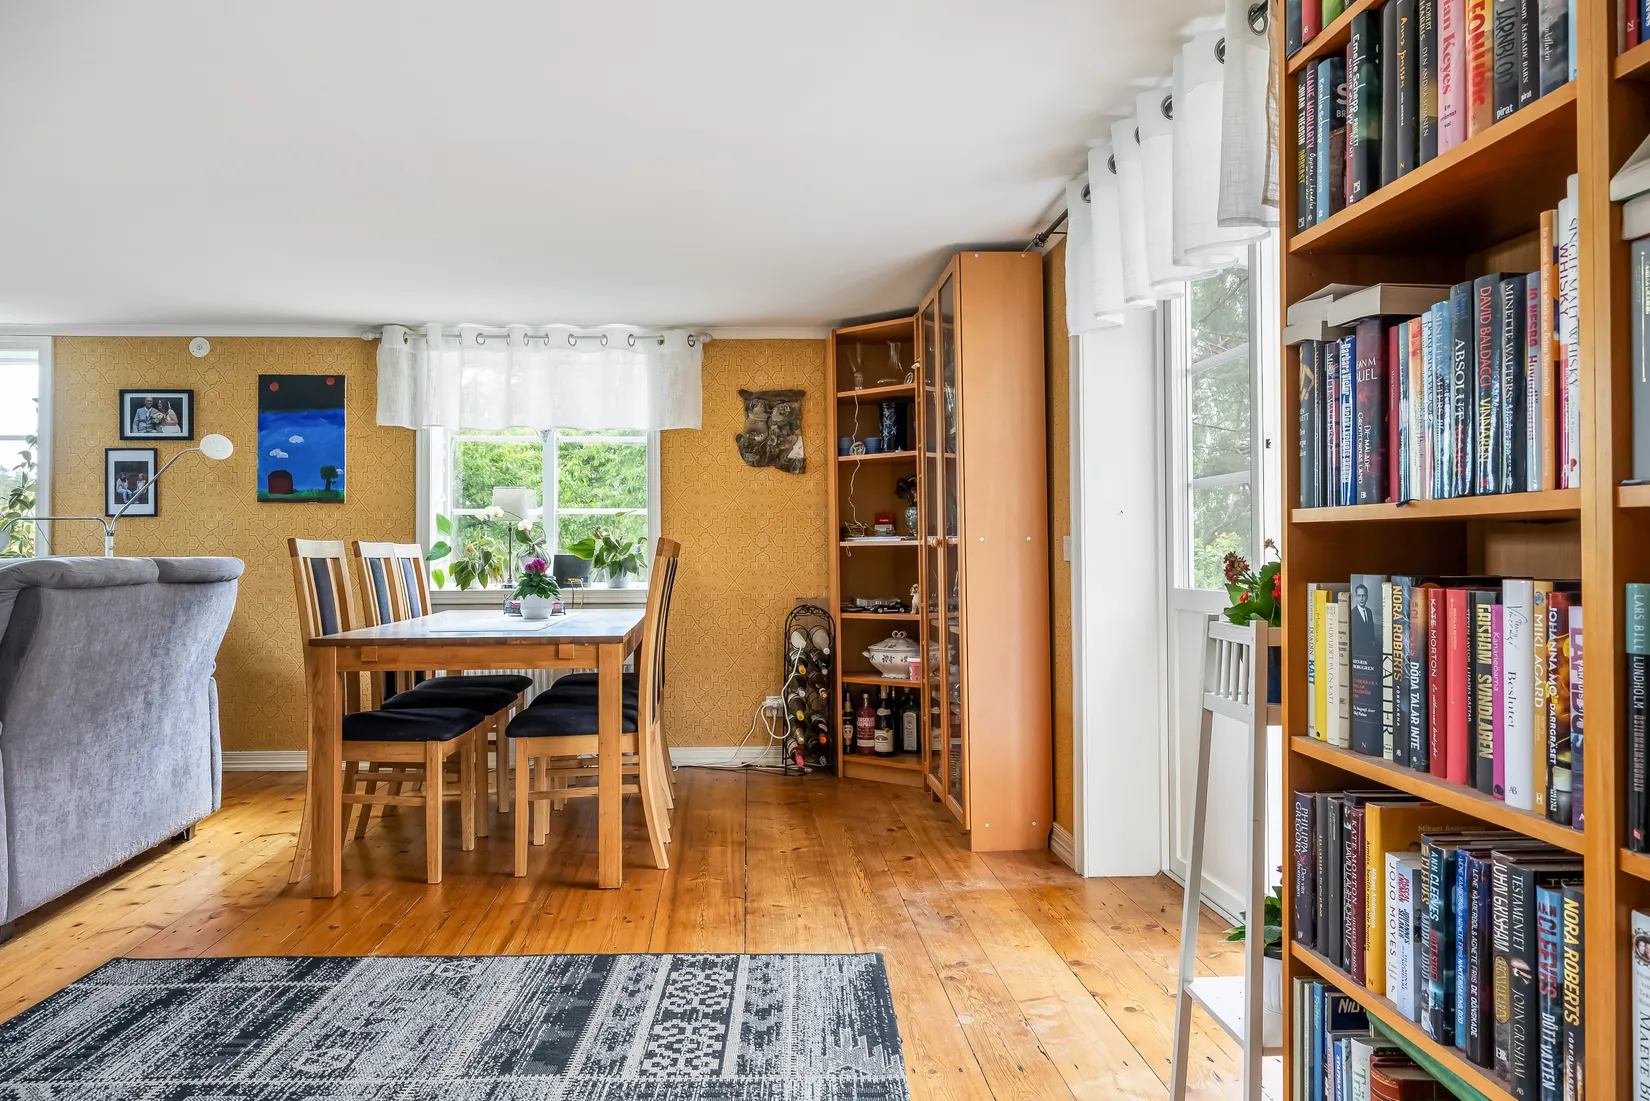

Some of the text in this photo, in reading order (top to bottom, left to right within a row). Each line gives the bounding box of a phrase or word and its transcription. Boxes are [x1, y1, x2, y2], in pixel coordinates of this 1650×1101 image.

[1400, 17, 1408, 46] Anna
[1496, 6, 1518, 86] JÄRNBLOD
[1521, 23, 1529, 84] ÄLSKADE BARN
[1350, 34, 1366, 112] Emelie Schepp
[1397, 49, 1407, 88] Jansson
[1440, 31, 1456, 96] Keyes
[1298, 84, 1306, 145] JOHAN THEORIN
[1306, 70, 1315, 149] LIANE MORIARTY
[1497, 104, 1514, 120] pirat
[1520, 90, 1532, 102] pirat
[1543, 226, 1549, 237] En
[1528, 287, 1538, 300] JO
[1543, 280, 1549, 293] om
[1560, 242, 1568, 316] WHISKY
[1568, 277, 1578, 322] MALT
[1504, 283, 1514, 340] MINETTE
[1542, 294, 1550, 321] whisky
[1341, 343, 1351, 374] Barbara
[1435, 311, 1443, 361] MINETTE
[1542, 332, 1551, 353] Örjan
[1568, 326, 1578, 388] WHISKY
[1341, 374, 1351, 396] Victor
[1435, 365, 1443, 416] WALTERS
[1479, 285, 1492, 463] DAVID BALDACCI VINNAREN
[1504, 343, 1514, 399] WALTERS
[1455, 338, 1466, 476] ABSOLUT MAKT
[1364, 425, 1372, 472] DE MÅLADE
[1393, 585, 1403, 681] NORA ROBERTS
[1410, 661, 1421, 690] DÖDA
[1477, 603, 1493, 759] GRISHAM SVINDLAREN
[1493, 632, 1501, 692] Kanarieöarna
[1549, 605, 1558, 765] JOHANNA MO DARRGRÄSET
[1410, 692, 1420, 725] TALAR
[1507, 671, 1517, 729] Beslutet
[1633, 594, 1645, 793] LARS BILL LUNDHOLM ÖSTERMALMSMORDEN
[1410, 726, 1420, 750] INTE
[1389, 862, 1397, 901] JOJO
[1421, 857, 1430, 905] CLEEVES
[1493, 860, 1509, 953] JOHN GRISHAM
[1389, 905, 1397, 957] MOYES
[1430, 851, 1439, 984] ANN CLEEVES STOFT
[1512, 874, 1525, 953] TESTAMENTET
[1564, 897, 1580, 945] NORA
[1539, 915, 1558, 999] CLEEVES
[1471, 985, 1478, 996] DE
[1563, 951, 1580, 1027] ROBERTS
[1471, 997, 1479, 1038] OÖNSKADE
[1513, 988, 1526, 1079] JOHN GRISHAM
[1640, 1010, 1650, 1078] MAEVE
[1541, 1012, 1558, 1091] DÖTT VATTEN
